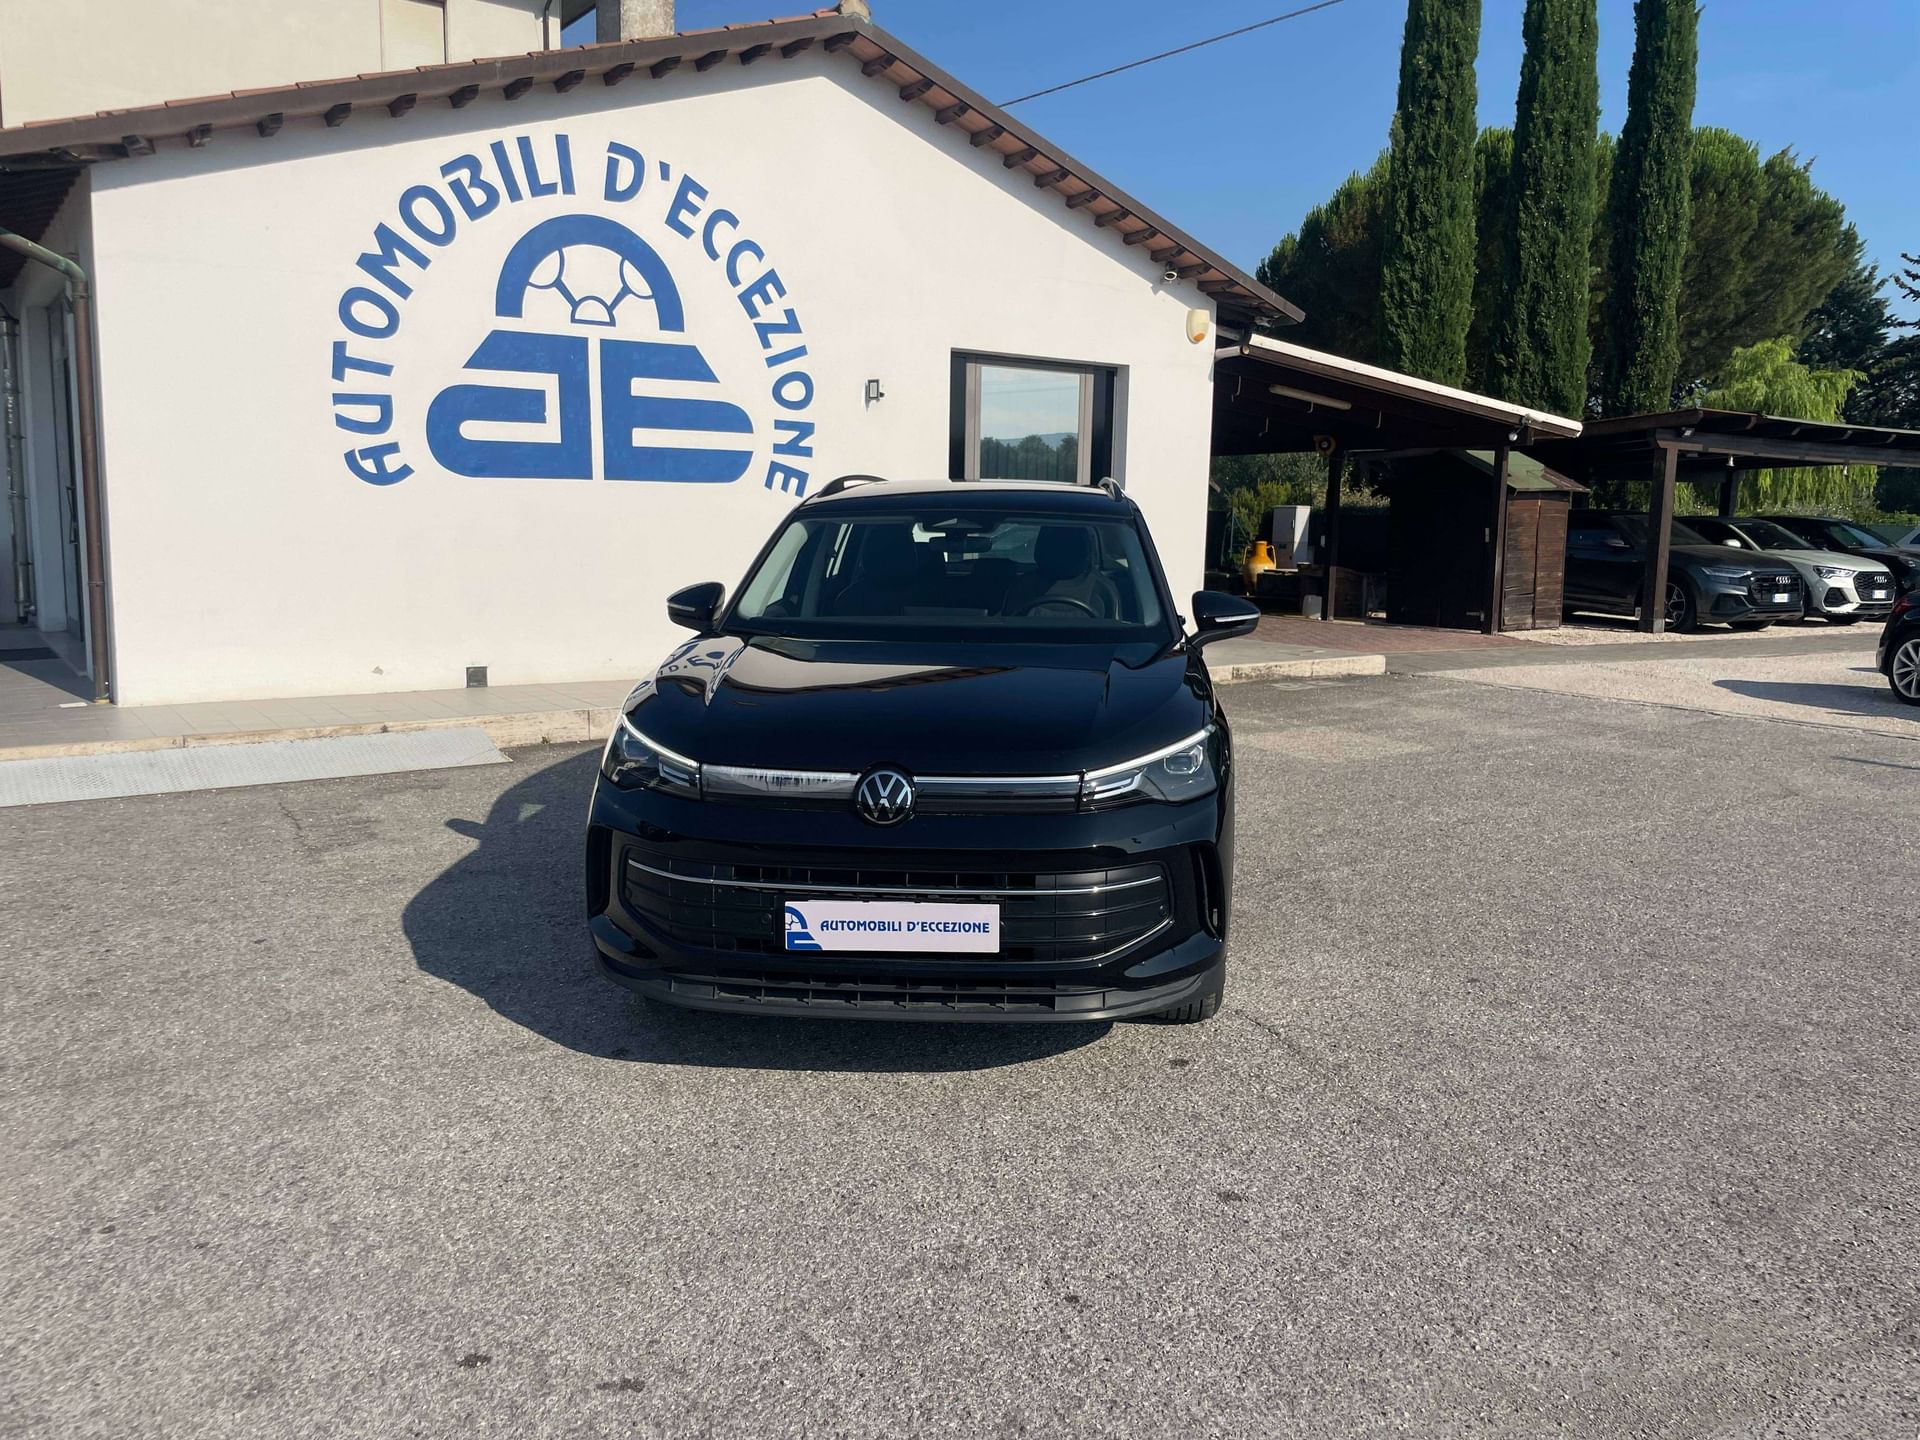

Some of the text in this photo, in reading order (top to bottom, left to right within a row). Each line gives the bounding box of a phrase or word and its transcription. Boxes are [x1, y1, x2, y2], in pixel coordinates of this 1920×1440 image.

[332, 134, 815, 497] AUTOMOBILI D'ECCEZIONE
[820, 920, 990, 933] AUTOMOBILI D'ECCEZIONE
